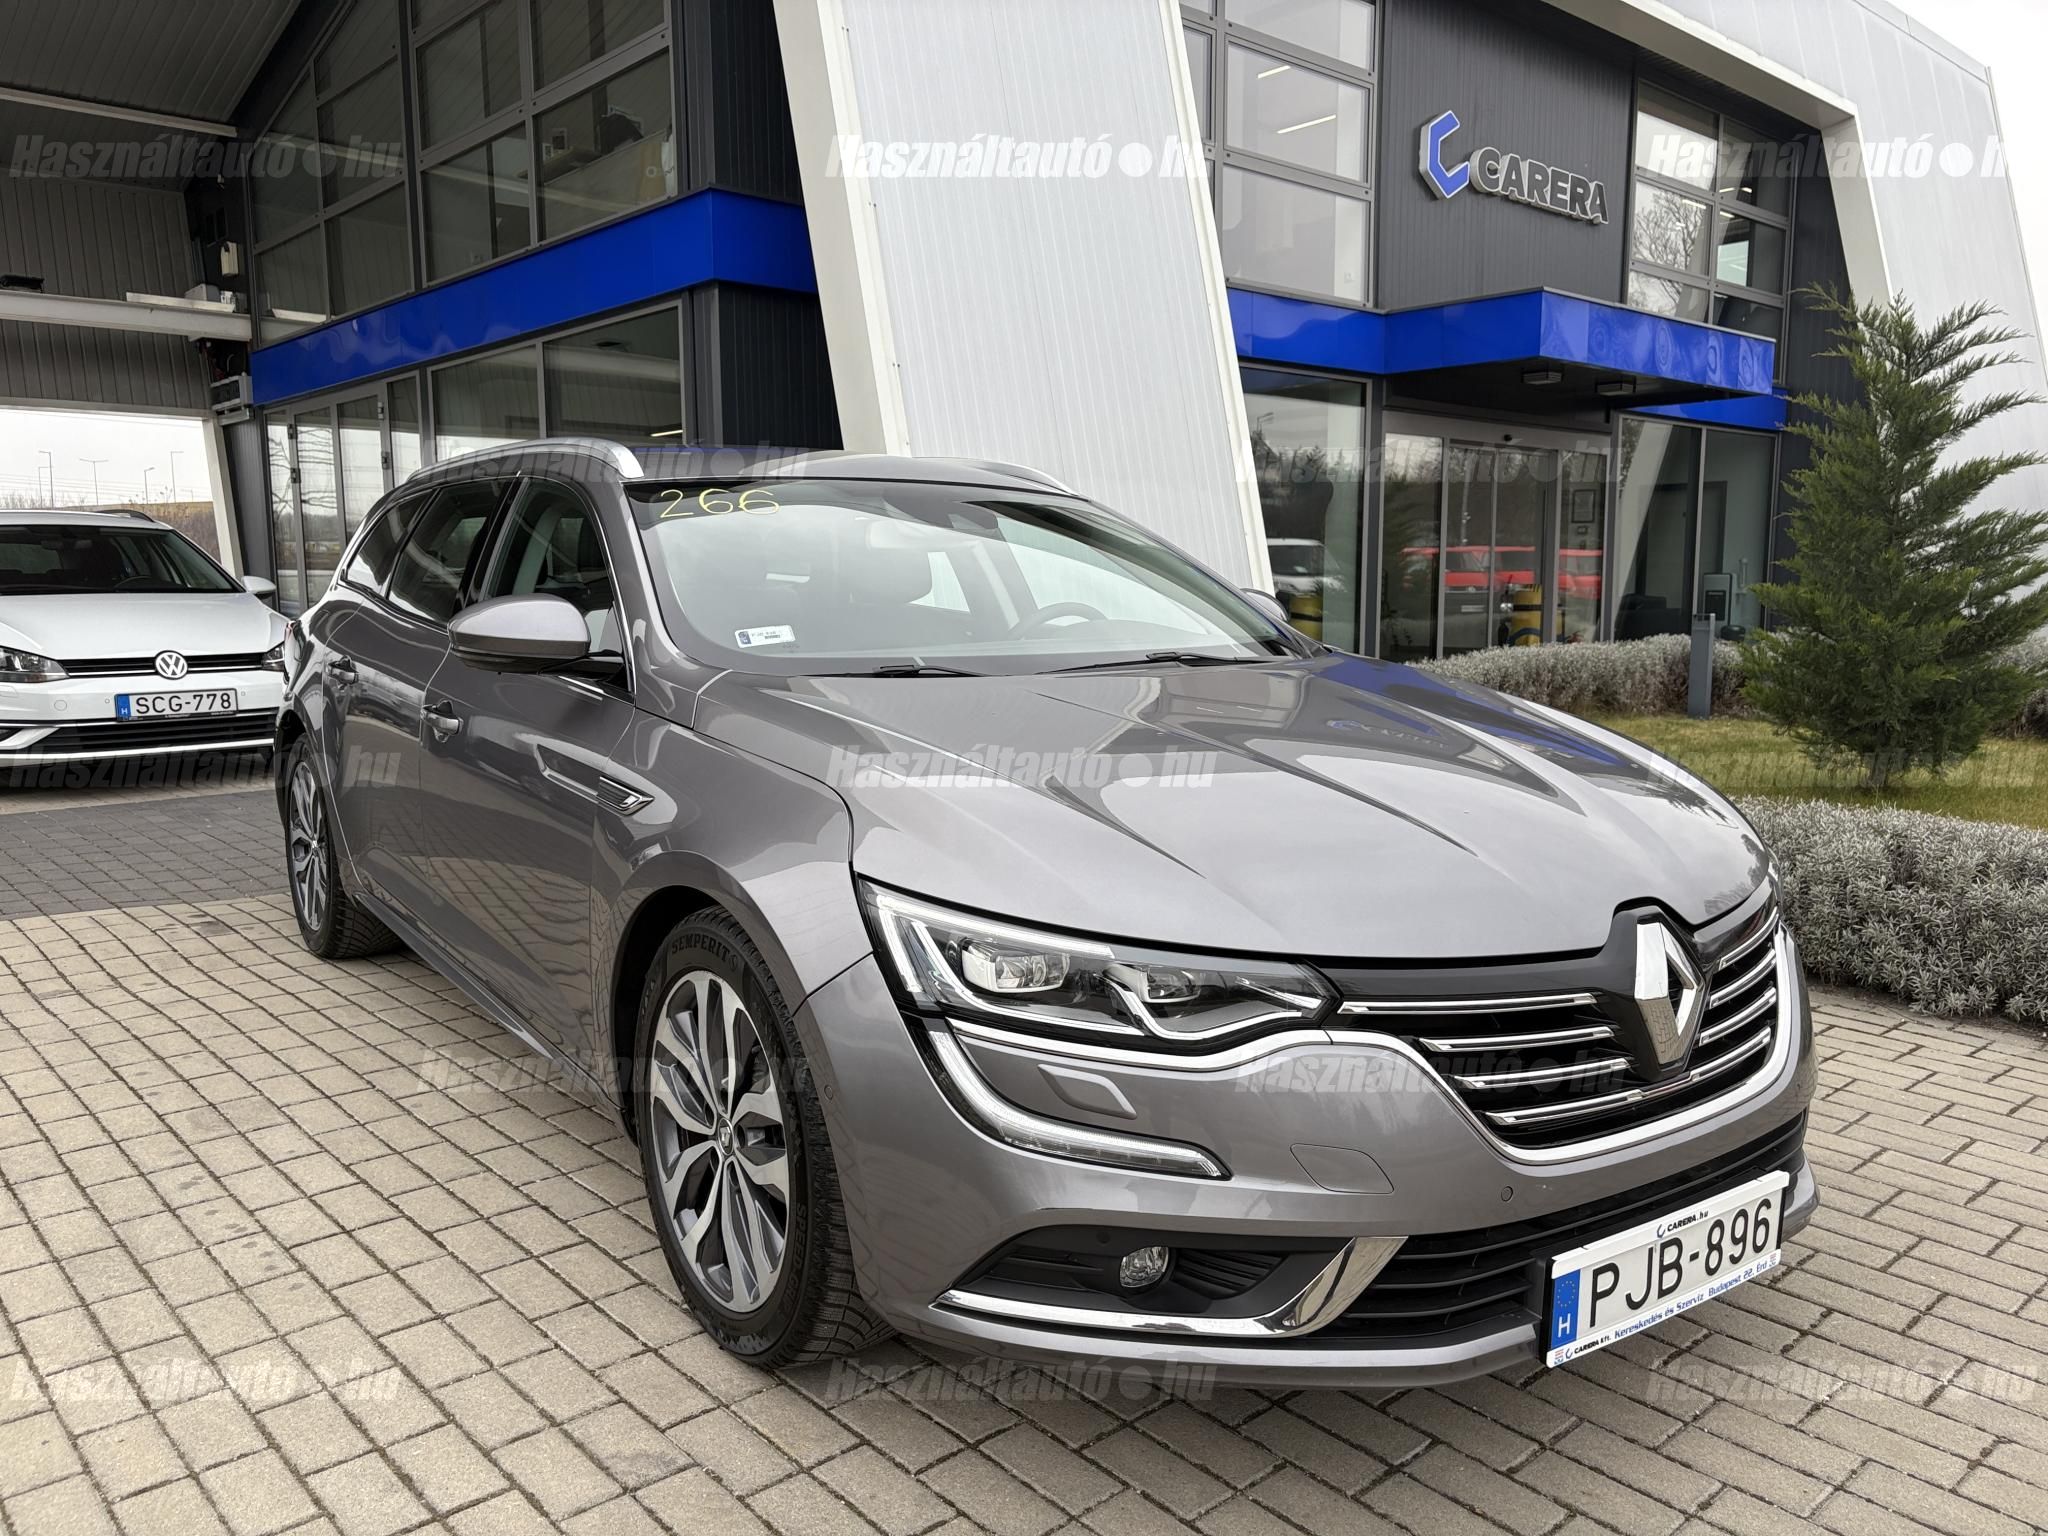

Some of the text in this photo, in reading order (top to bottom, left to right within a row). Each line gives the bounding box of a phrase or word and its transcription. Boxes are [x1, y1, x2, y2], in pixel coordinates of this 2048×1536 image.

[1470, 147, 1609, 225] CARERA
[660, 488, 780, 518] 266
[120, 706, 129, 715] H
[135, 692, 232, 714] SCG-778
[671, 933, 731, 963] SEMPERIT
[1667, 1210, 1709, 1232] CARERA.hu
[1589, 1198, 1772, 1328] PJB-896
[1557, 1313, 1571, 1338] H
[1574, 1339, 1599, 1354] CARERA
[1614, 1312, 1663, 1339] Kereskedés
[1664, 1306, 1674, 1317] és
[1708, 1275, 1742, 1297] Budapest
